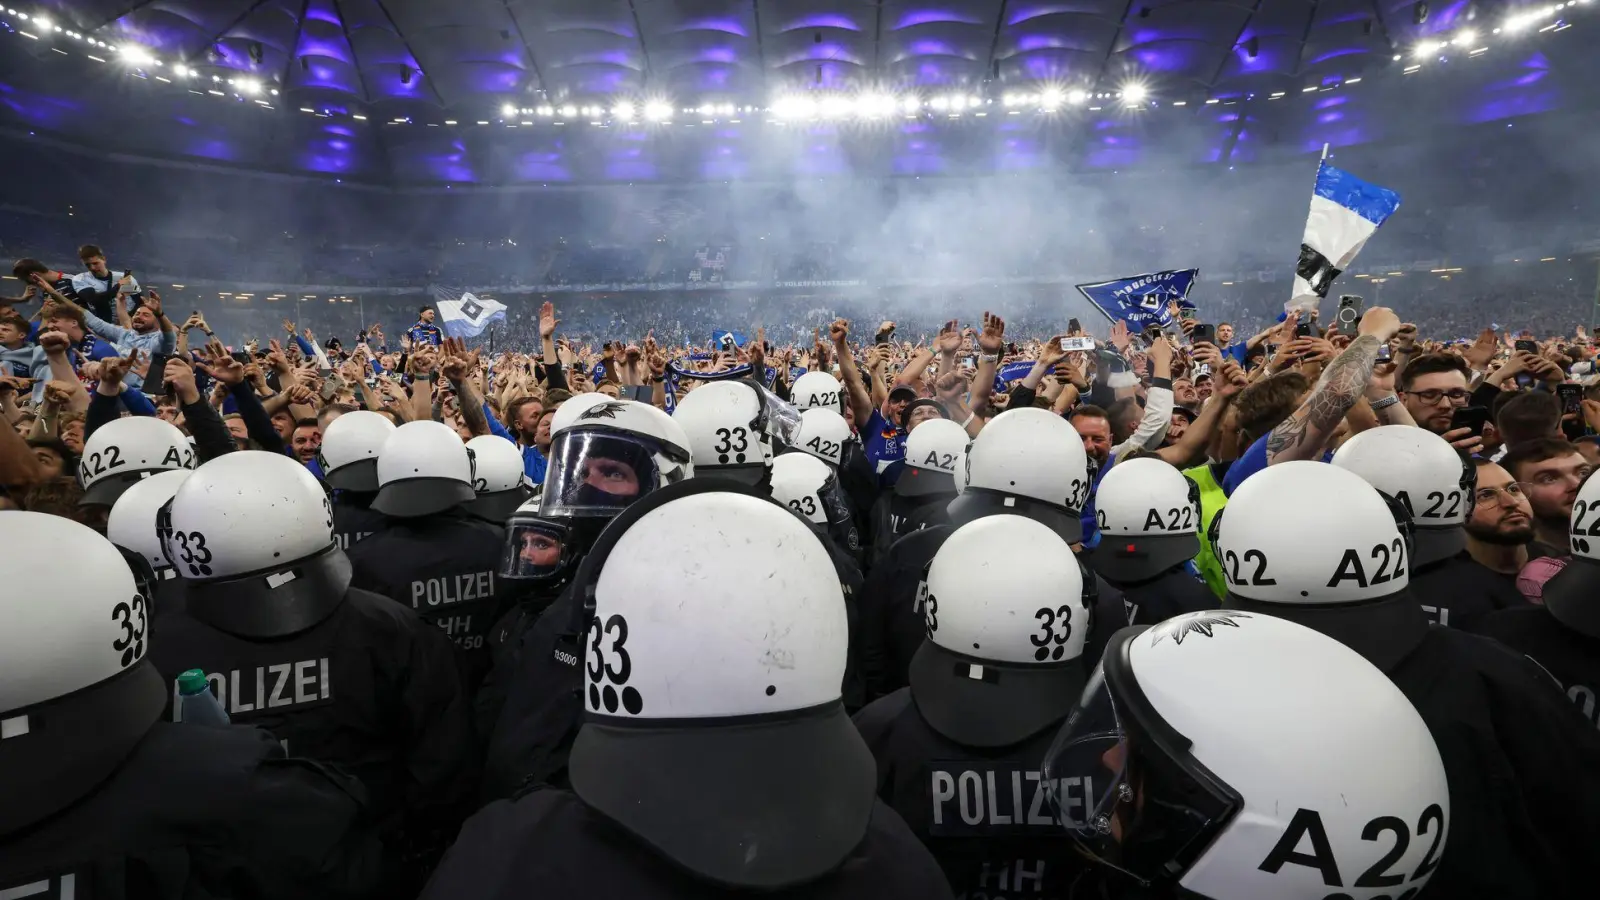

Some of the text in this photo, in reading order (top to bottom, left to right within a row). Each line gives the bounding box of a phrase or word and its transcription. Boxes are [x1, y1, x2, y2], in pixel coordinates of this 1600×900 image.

[808, 391, 838, 407] A22
[714, 427, 748, 453] 33
[806, 436, 840, 458] A22
[81, 445, 126, 484] A22
[1065, 479, 1087, 509] 33
[1143, 506, 1192, 531] A22
[175, 531, 212, 564] 33
[1326, 538, 1405, 588] A22
[411, 570, 495, 609] POLIZEI
[112, 594, 145, 651] 33
[1030, 604, 1072, 647] 33
[587, 614, 631, 685] 33
[931, 770, 1096, 829] POLIZEI
[1258, 803, 1444, 888] A22
